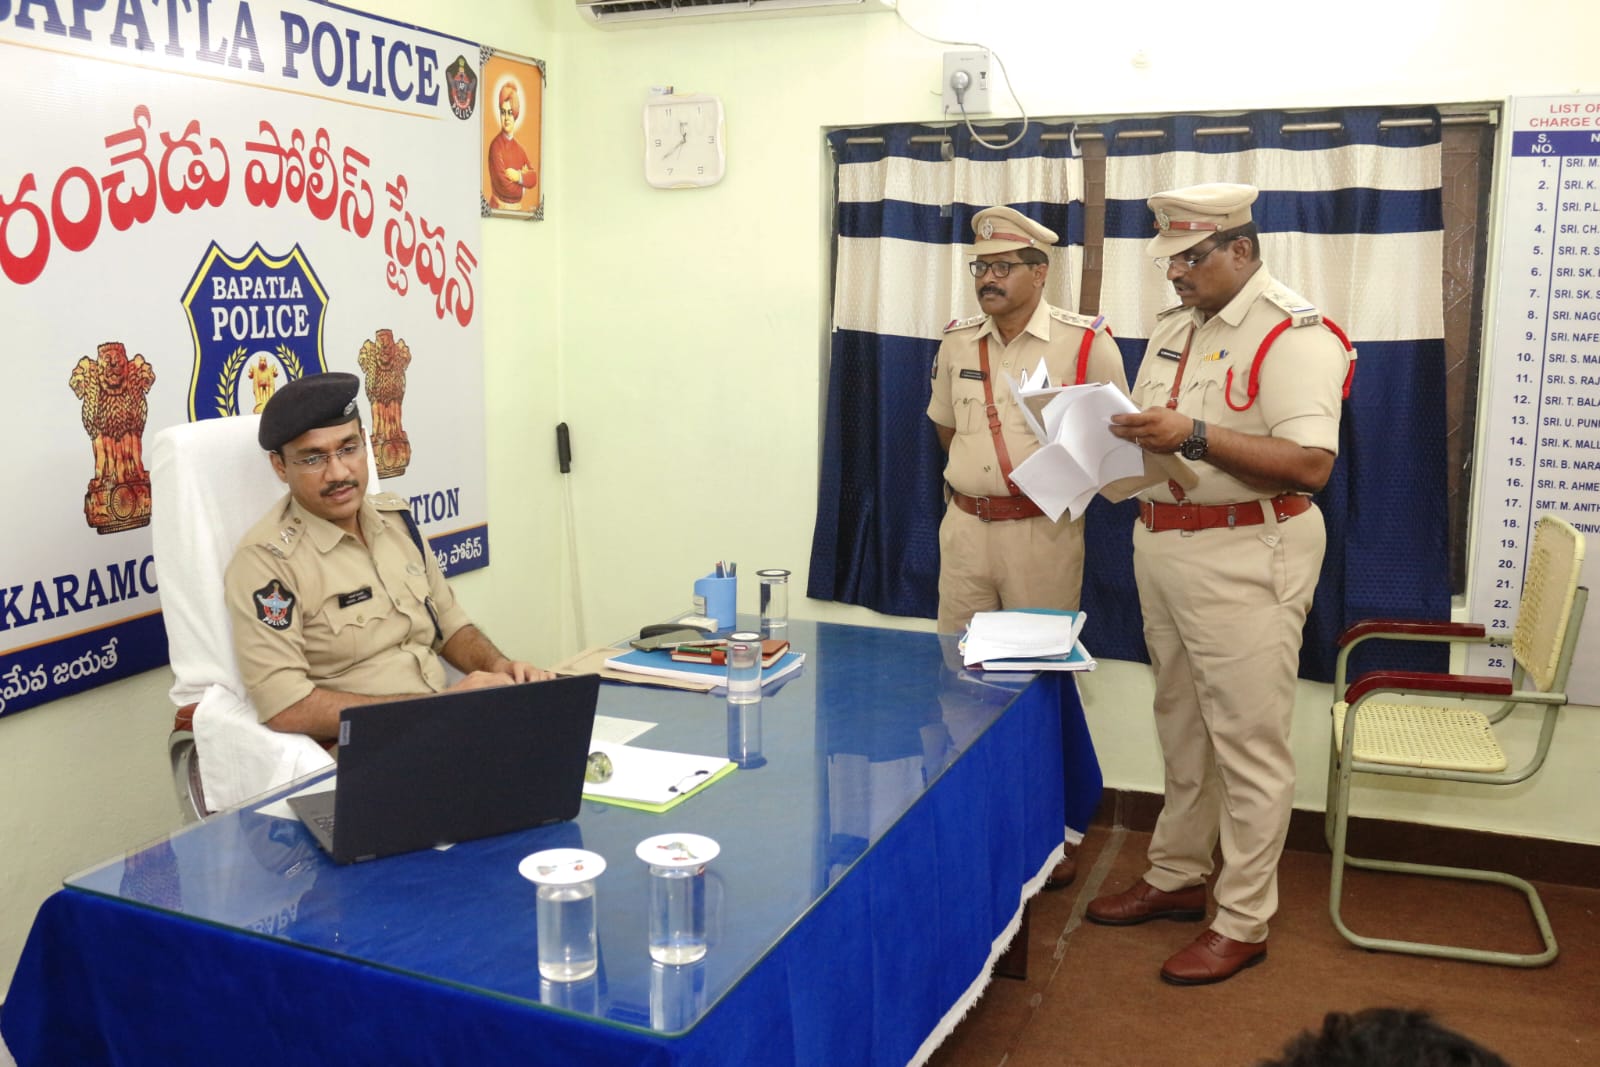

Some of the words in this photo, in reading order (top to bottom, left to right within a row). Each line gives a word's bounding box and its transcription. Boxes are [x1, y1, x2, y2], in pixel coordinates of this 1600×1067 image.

[280, 11, 440, 106] POLICE
[452, 102, 473, 120] POLICE
[1550, 104, 1580, 113] LIST
[1529, 117, 1590, 127] CHARGE
[1538, 134, 1550, 143] S.
[1531, 144, 1555, 154] NO.
[1541, 158, 1551, 167] 1.
[1566, 158, 1585, 168] SRI.
[1538, 180, 1549, 190] 2.
[1564, 180, 1583, 190] SRI.
[1586, 180, 1596, 190] K.
[1536, 202, 1547, 211] 3.
[1562, 202, 1581, 212] SRI.
[244, 120, 374, 239] పోలీస్
[384, 174, 478, 328] స్టేషన్
[1534, 224, 1546, 233] 4.
[1560, 224, 1579, 234] SRI.
[1533, 246, 1543, 255] 5.
[1558, 246, 1577, 255] SRI.
[1580, 246, 1590, 255] R.
[1531, 267, 1542, 276] 6.
[1556, 268, 1575, 277] SRI.
[1578, 268, 1595, 277] SK.
[211, 276, 304, 299] BAPATLA
[1530, 289, 1540, 298] 7.
[1554, 290, 1573, 299] SRI.
[1576, 290, 1593, 299] SK.
[1528, 310, 1538, 320] 8.
[1552, 311, 1571, 320] SRI.
[211, 304, 310, 341] POLICE
[1526, 331, 1536, 341] 9.
[1551, 332, 1570, 342] SRI.
[1517, 353, 1534, 362] 10.
[1549, 354, 1568, 363] SRI.
[1570, 354, 1580, 363] S.
[1516, 374, 1533, 383] 11.
[1547, 375, 1565, 385] SRI.
[1568, 375, 1578, 385] S.
[1513, 395, 1531, 404] 12.
[1545, 396, 1564, 407] SRI.
[1567, 396, 1574, 407] T.
[1512, 416, 1529, 425] 13.
[1543, 417, 1561, 428] SRI.
[1565, 417, 1574, 428] U.
[1510, 437, 1527, 446] 14.
[1541, 438, 1560, 449] SRI.
[1563, 438, 1572, 449] K.
[1508, 457, 1525, 467] 15.
[1539, 459, 1558, 470] SRI.
[1560, 459, 1570, 470] B.
[1506, 478, 1524, 487] 16.
[1537, 480, 1556, 491] SRI.
[1559, 480, 1568, 491] R.
[409, 487, 460, 525] TION
[1505, 498, 1521, 508] 17.
[1536, 500, 1557, 512] SMT.
[1560, 500, 1571, 512] M.
[1503, 519, 1520, 528] 18.
[1501, 539, 1518, 549] 19.
[1498, 560, 1516, 569] 20.
[1496, 580, 1514, 589] 21.
[1494, 600, 1512, 609] 22.
[262, 616, 289, 626] POLICE
[1492, 619, 1509, 628] 23.
[53, 636, 119, 685] జయతే
[1488, 659, 1506, 668] 25.
